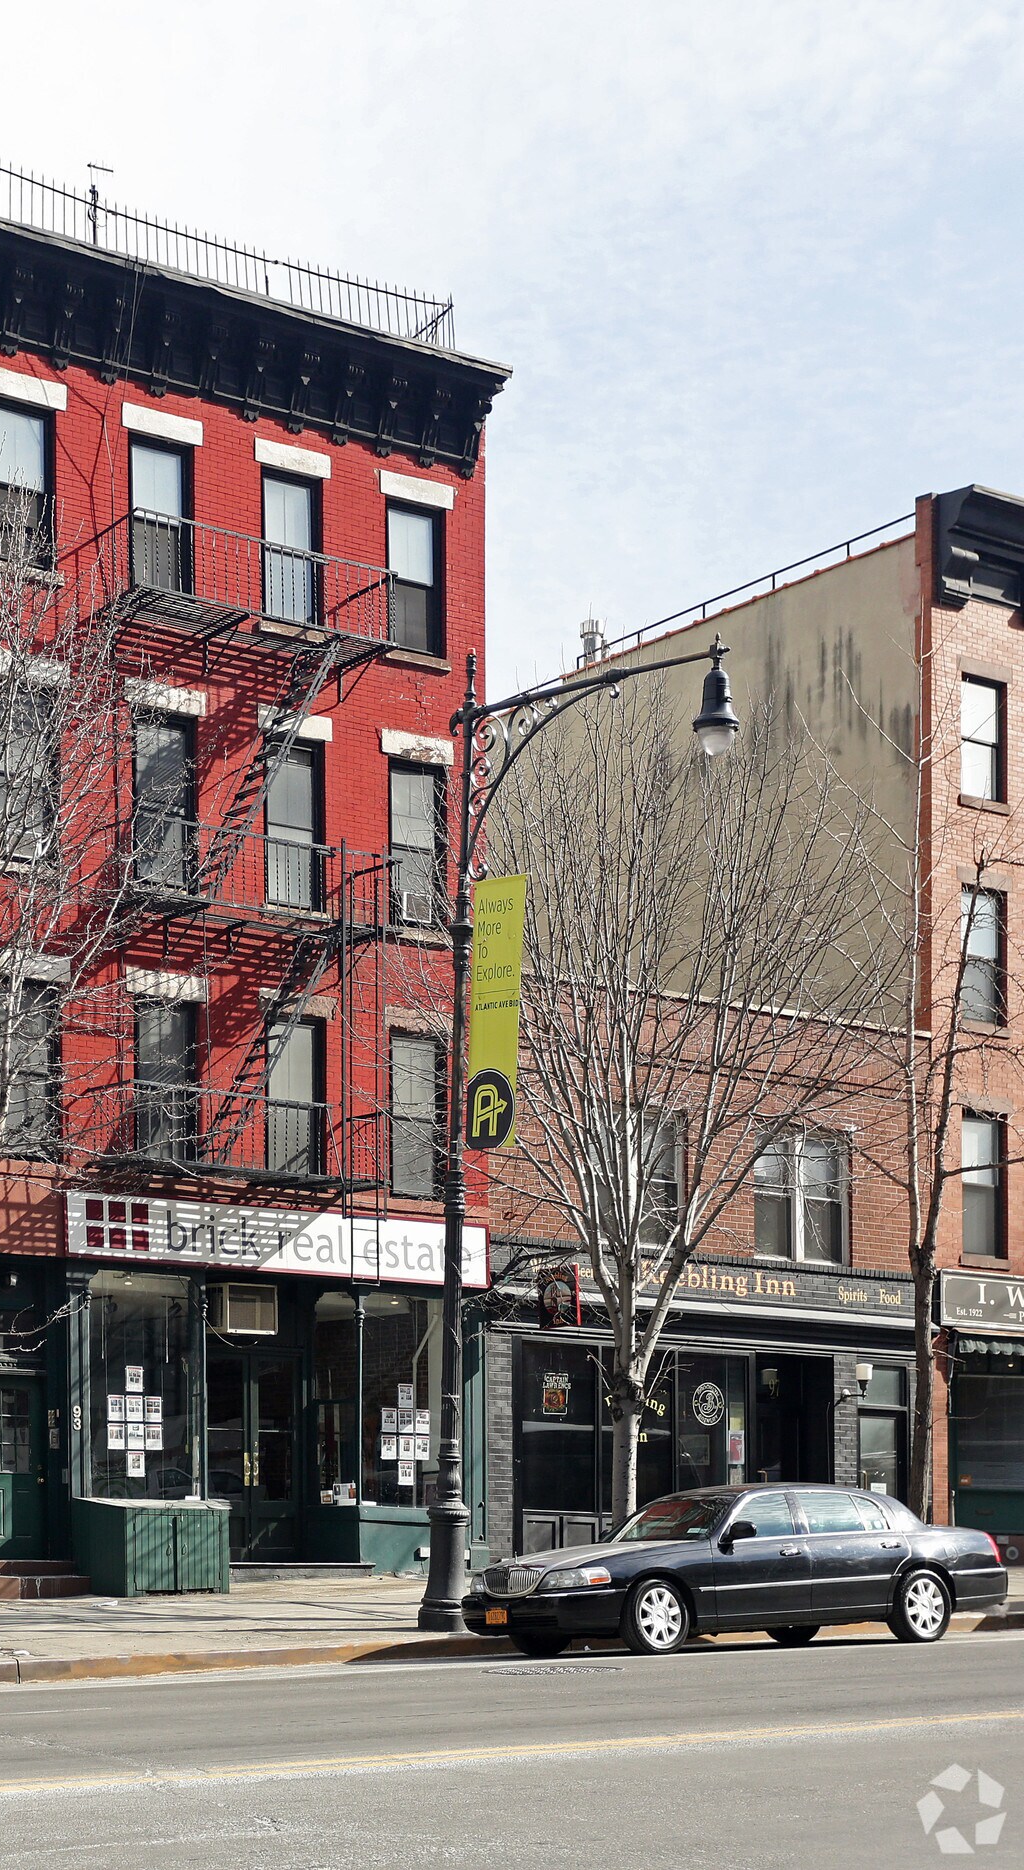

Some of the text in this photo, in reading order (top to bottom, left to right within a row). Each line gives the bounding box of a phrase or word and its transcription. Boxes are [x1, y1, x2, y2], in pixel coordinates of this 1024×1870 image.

[478, 898, 514, 915] Always
[477, 921, 502, 938] More
[477, 942, 488, 959] To
[476, 964, 515, 982] Explore.
[475, 1001, 498, 1012] ATLANTIC
[498, 1000, 509, 1009] AVE
[166, 1210, 260, 1258] brick
[278, 1225, 348, 1265] real
[754, 1271, 797, 1296] Inn
[838, 1286, 868, 1304] Spirits
[879, 1288, 902, 1305] Food
[956, 1306, 983, 1318] Est. 1922
[542, 1382, 572, 1390] LAWRENCE
[72, 1405, 82, 1431] 93
